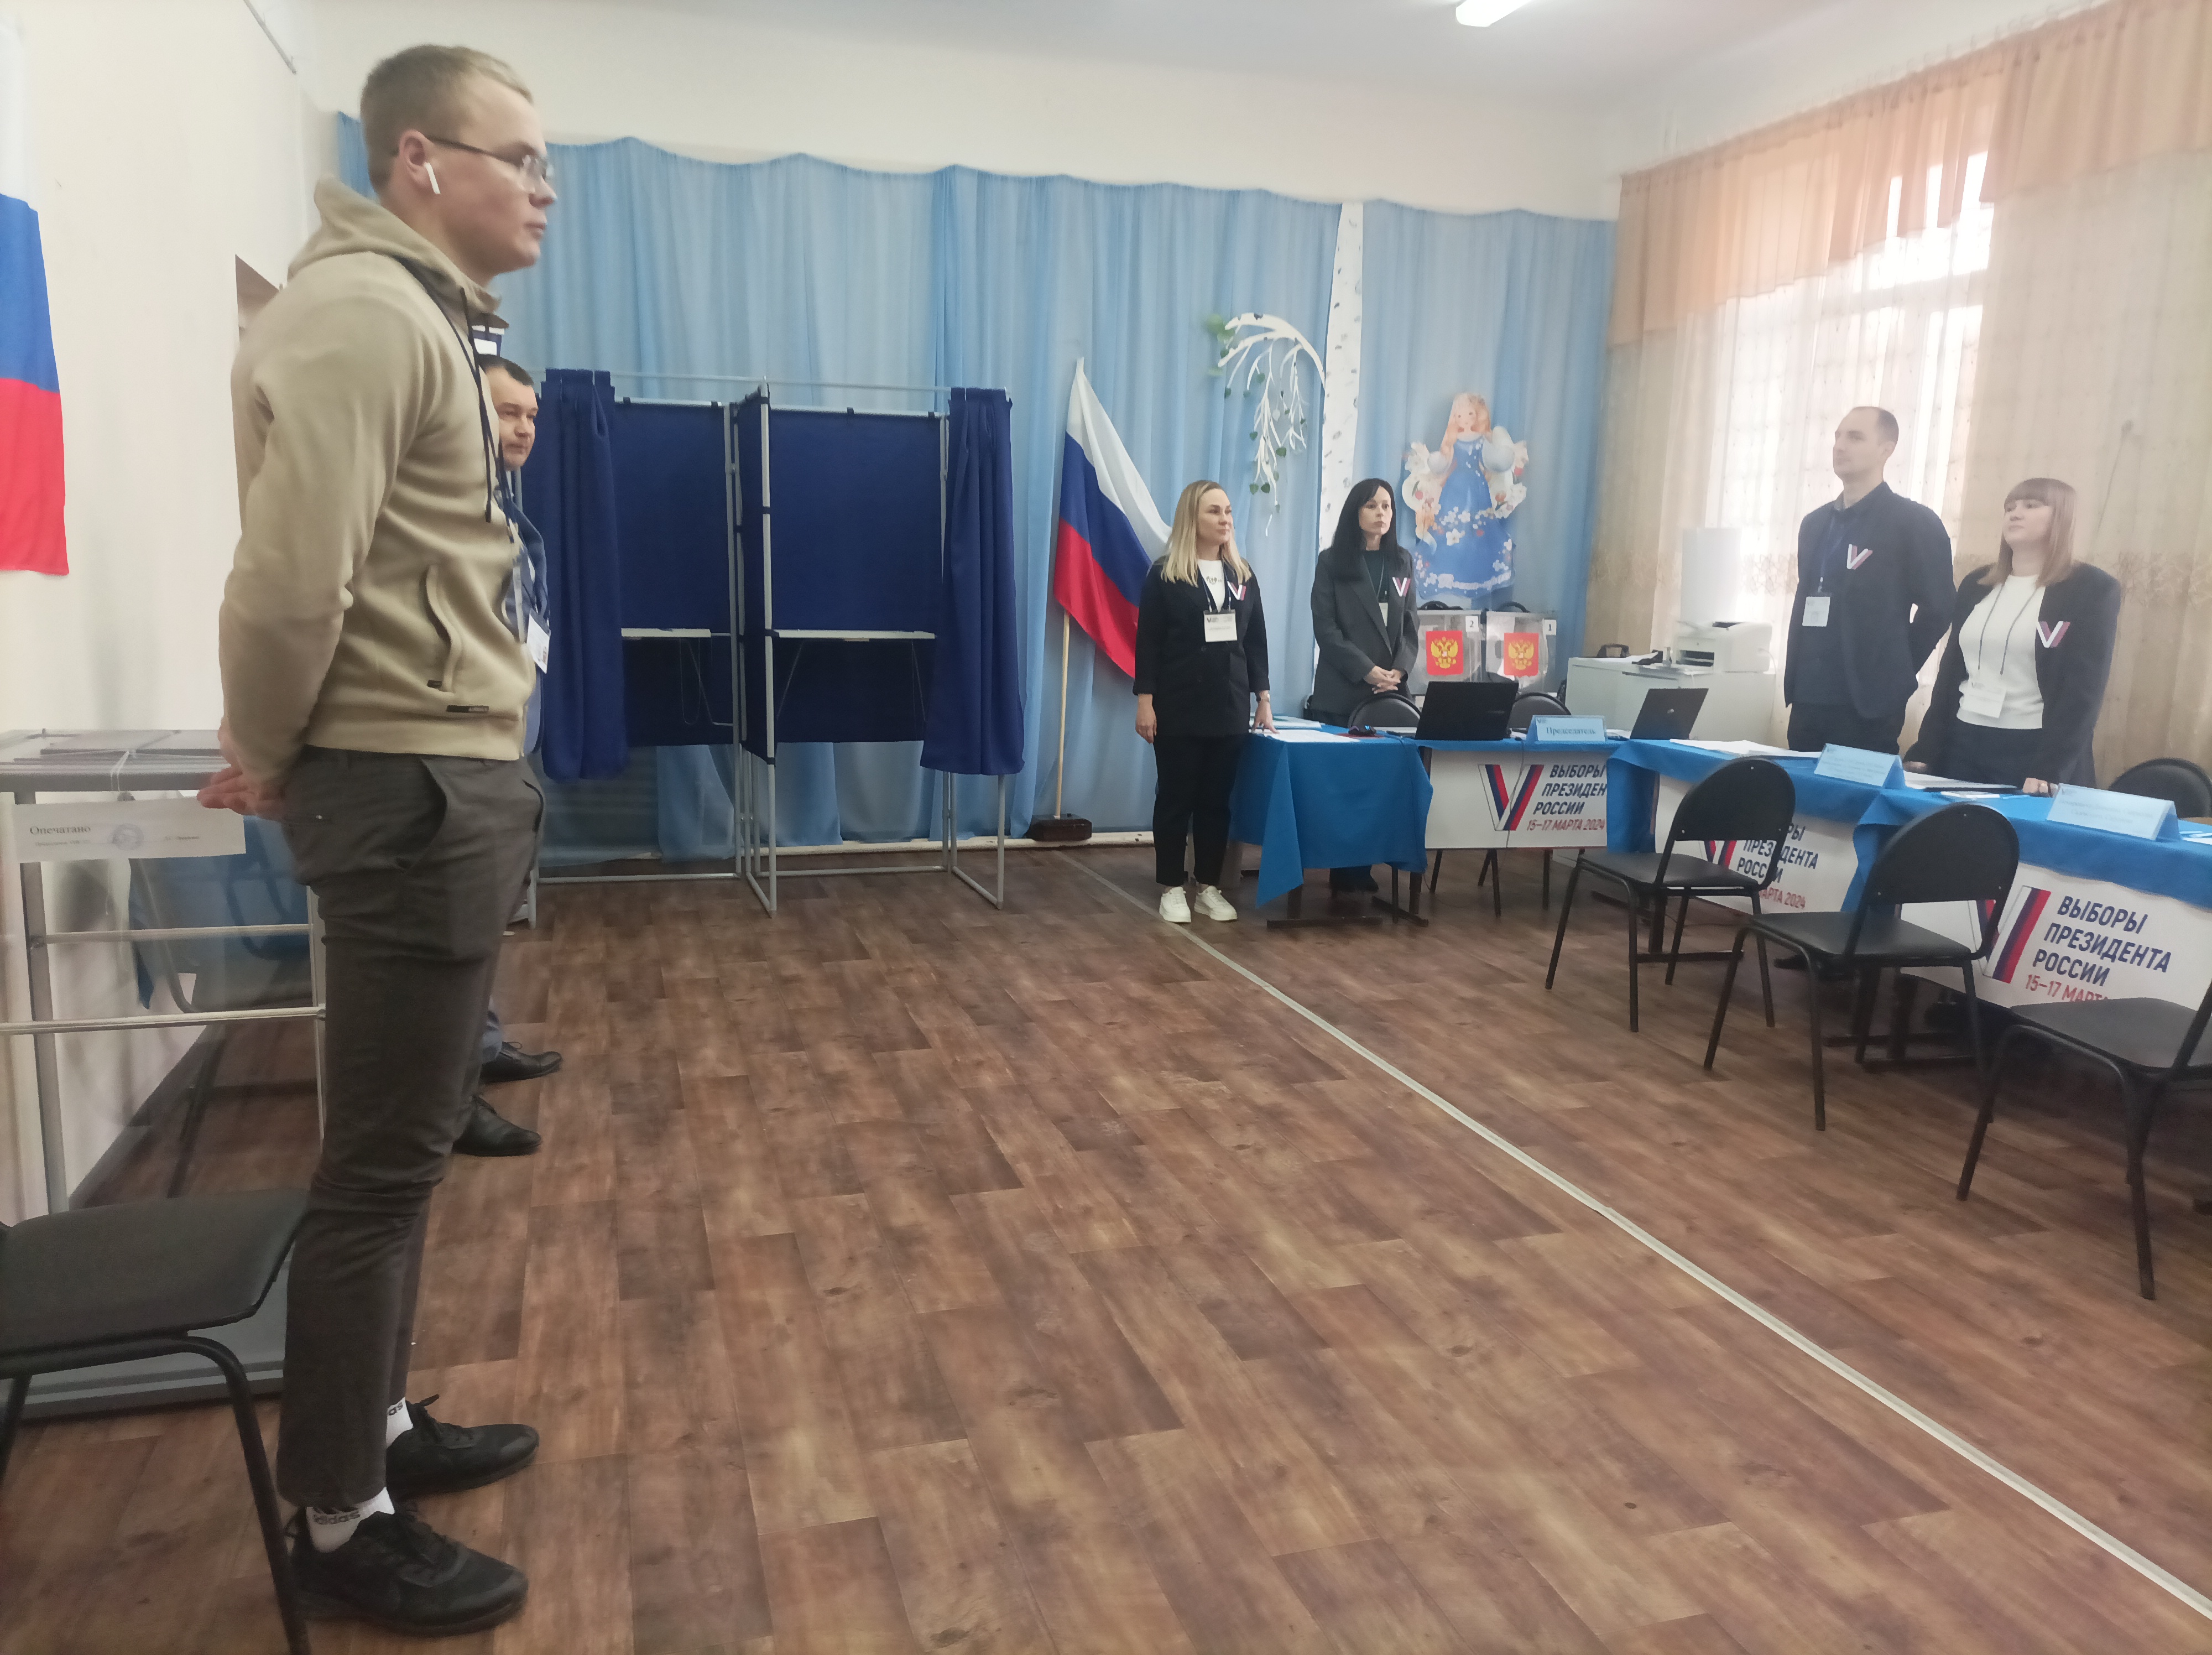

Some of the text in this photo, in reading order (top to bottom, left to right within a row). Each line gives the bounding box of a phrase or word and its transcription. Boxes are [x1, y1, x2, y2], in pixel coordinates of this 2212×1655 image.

[1546, 726, 1596, 736] Председатель
[1549, 764, 1606, 778] ВЫБОРЫ
[1541, 783, 1608, 798] ПРЕЗИДЕН
[1532, 802, 1585, 815] РОССИИ
[30, 825, 91, 835] Опечатано
[1553, 819, 1583, 830] МАРТА
[1583, 819, 1606, 830] 2024
[1743, 840, 1819, 869] ПРЕЗДЕНТА
[1736, 857, 1783, 883] РОССИ
[1784, 892, 1806, 909] 2024
[2057, 896, 2148, 934] ВЫБОРЫ
[2044, 923, 2171, 972] ПРЕЗИДЕНТА
[2032, 949, 2110, 987] РОССИИ
